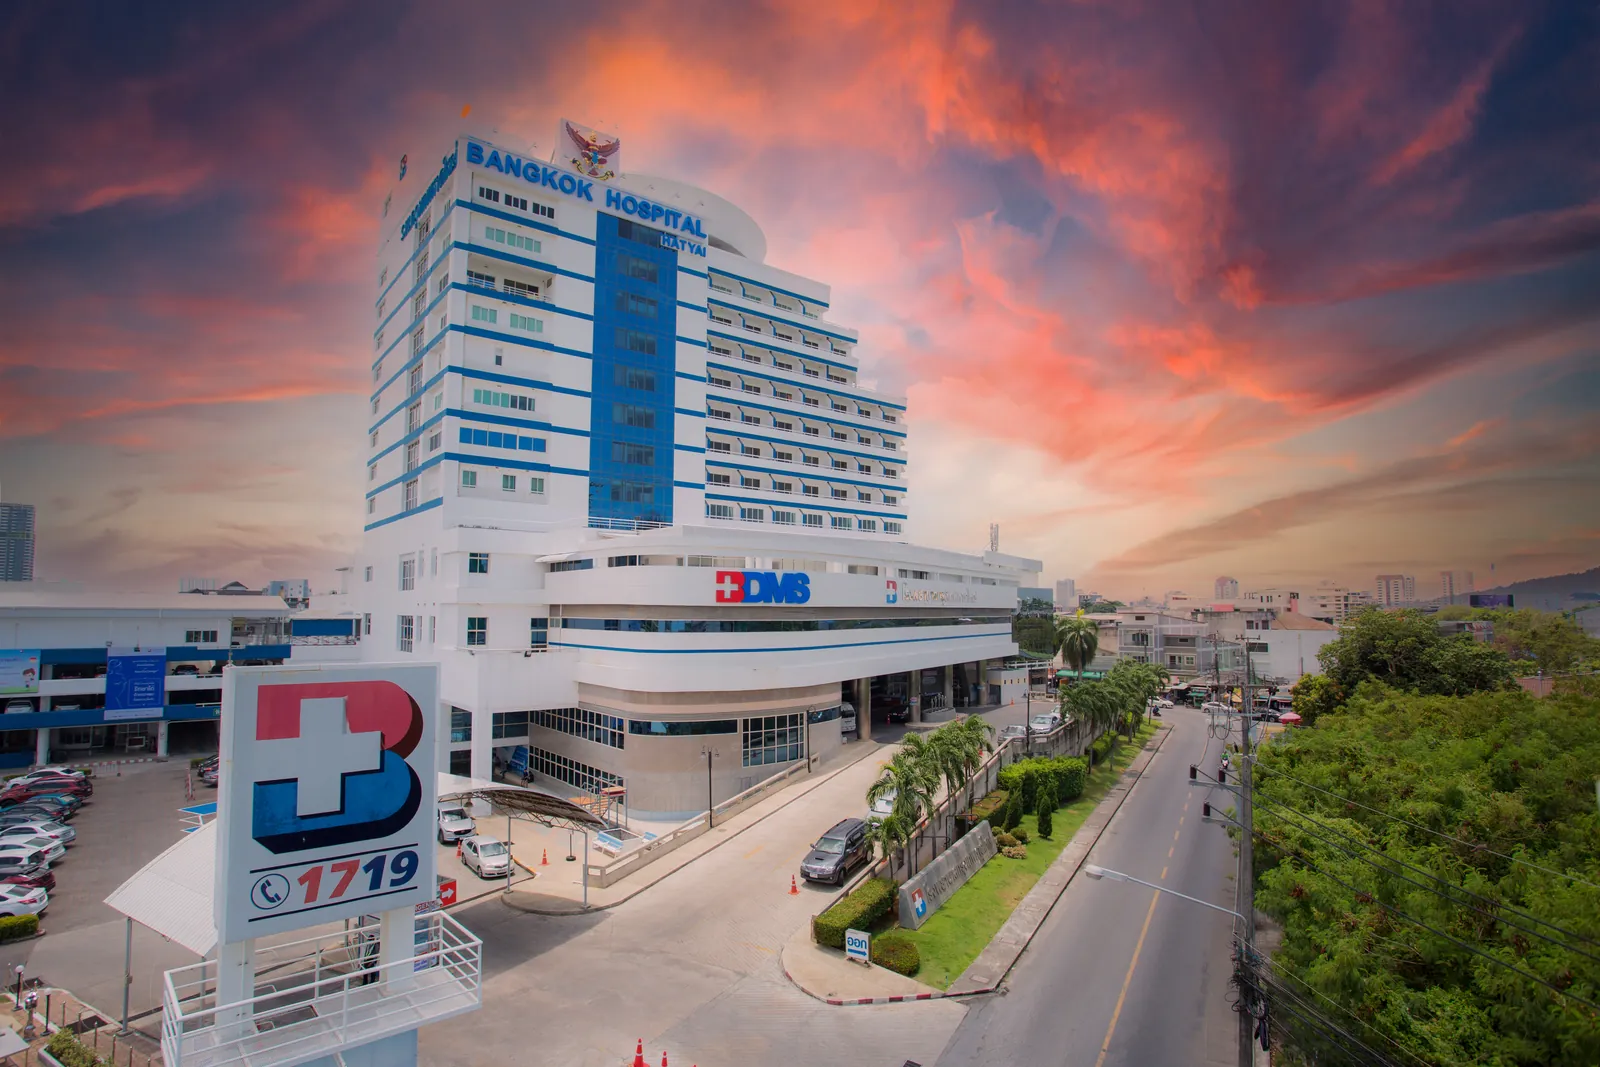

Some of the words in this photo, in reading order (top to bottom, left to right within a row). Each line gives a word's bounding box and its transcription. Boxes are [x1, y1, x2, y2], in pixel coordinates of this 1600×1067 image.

[466, 142, 594, 202] BANGKOK
[606, 188, 707, 239] HOSPITAL
[662, 233, 707, 257] HATYAI
[297, 850, 419, 905] 1719
[847, 936, 867, 950] ออก
